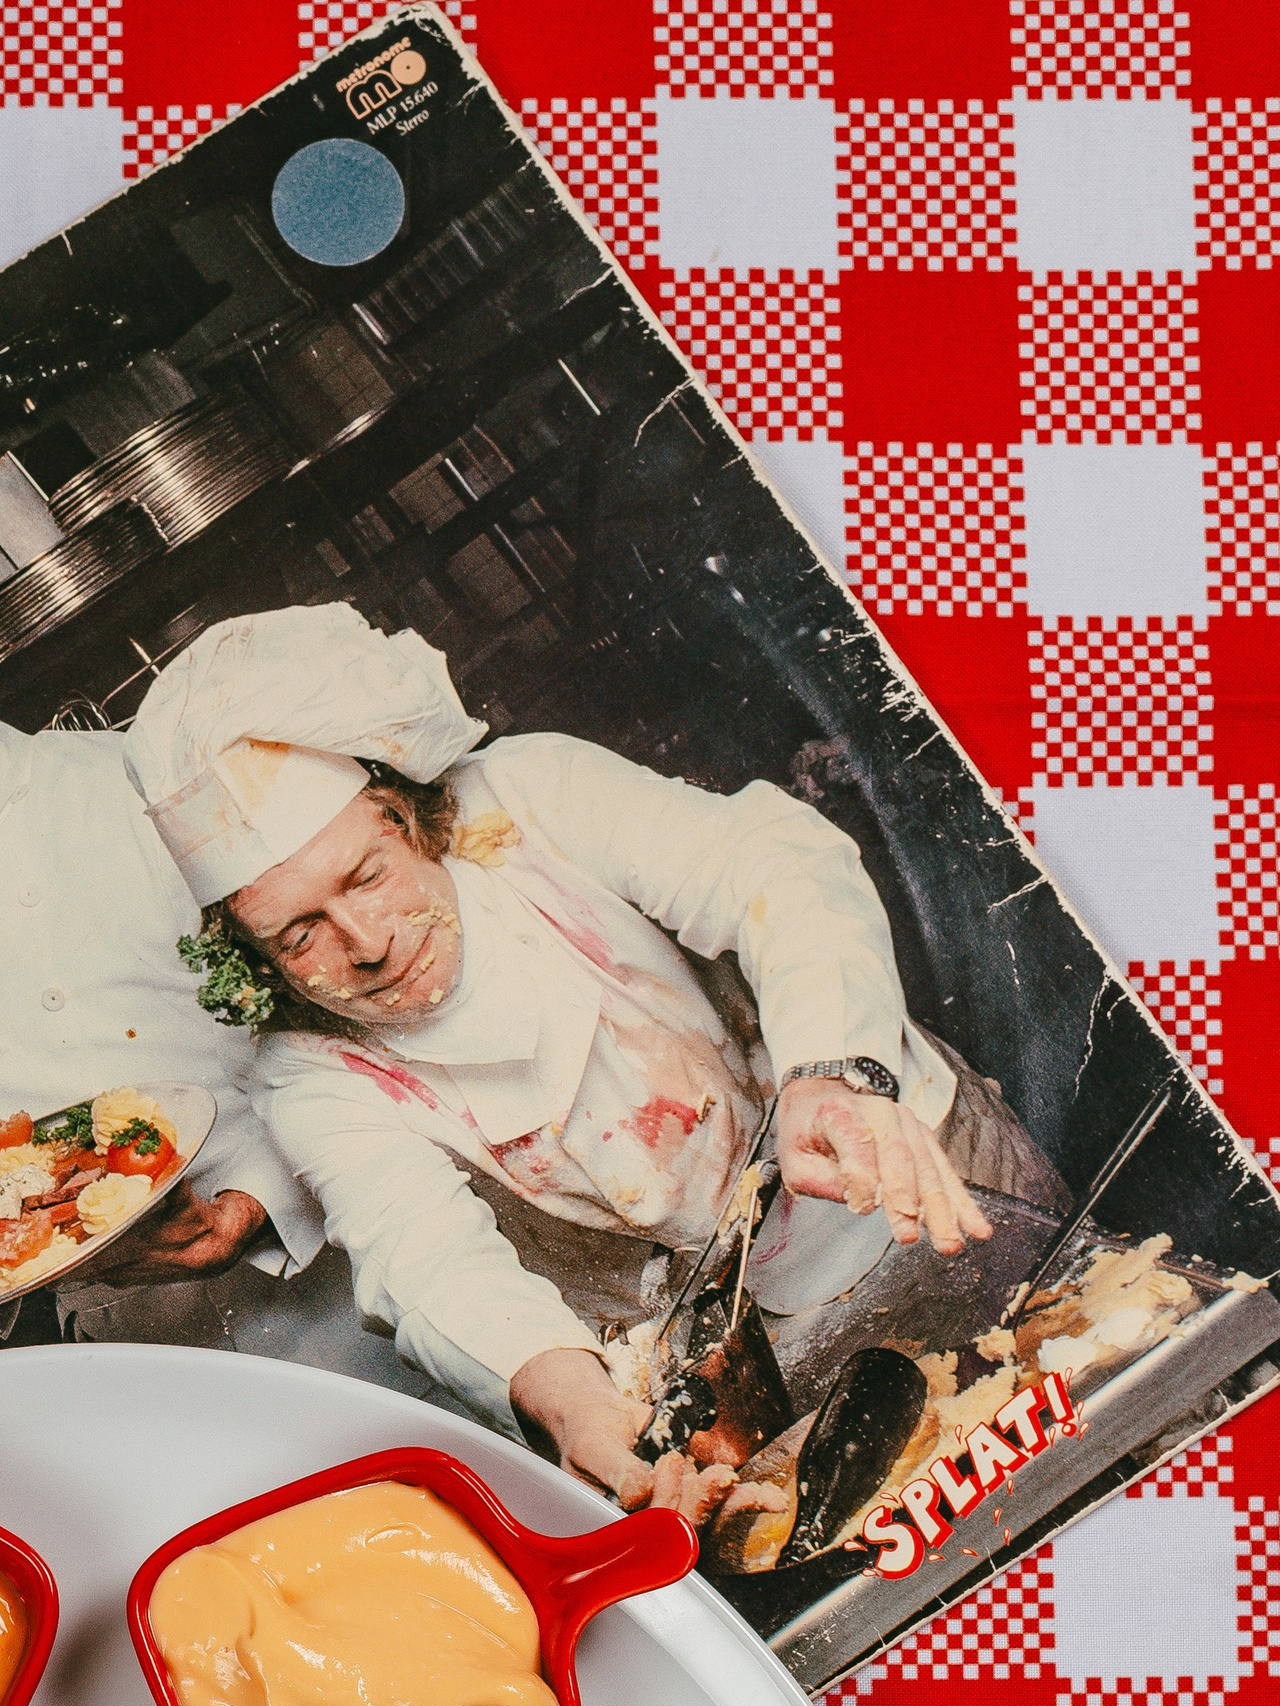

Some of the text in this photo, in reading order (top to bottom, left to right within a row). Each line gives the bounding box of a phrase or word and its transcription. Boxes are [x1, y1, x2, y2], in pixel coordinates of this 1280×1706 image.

[366, 81, 439, 136] MLP 15.640
[395, 109, 430, 136] Stereo
[863, 1370, 1078, 1581] SPLAT!
